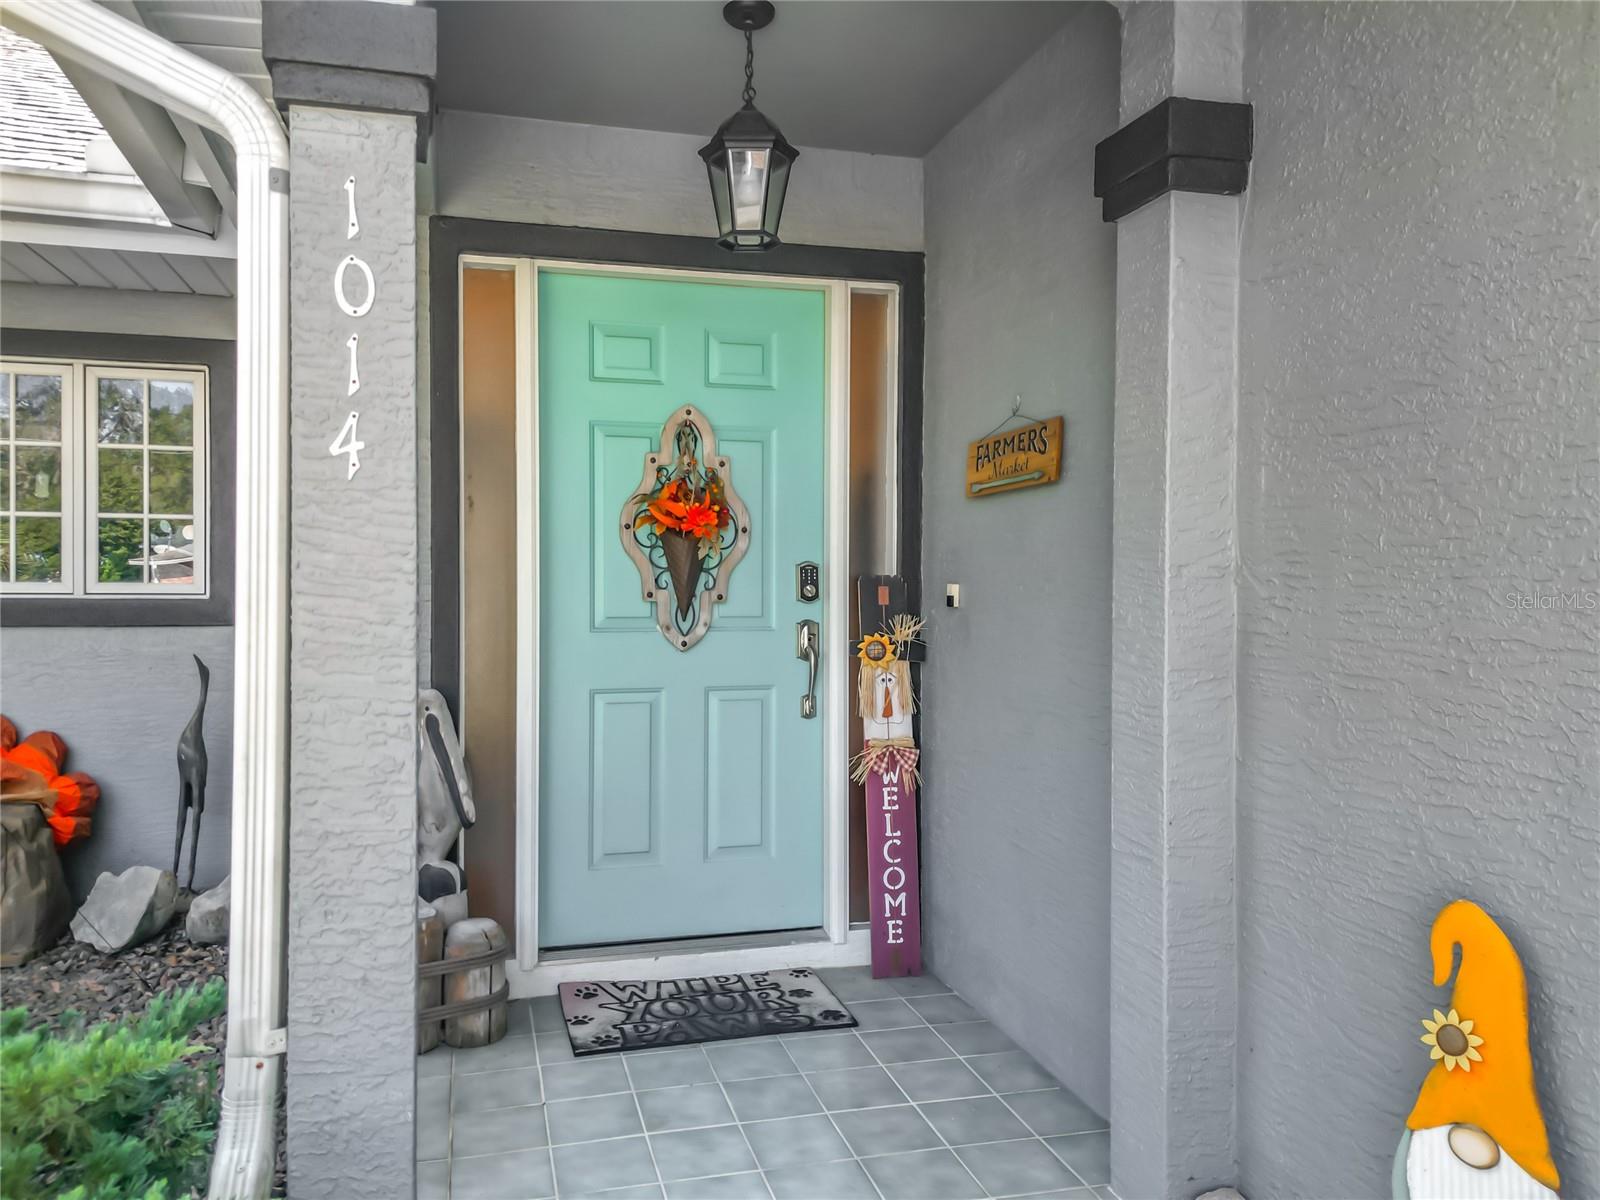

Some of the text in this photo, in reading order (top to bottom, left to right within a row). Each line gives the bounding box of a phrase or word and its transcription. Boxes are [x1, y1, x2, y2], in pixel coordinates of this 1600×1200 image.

[329, 176, 375, 480] 1014
[976, 425, 1048, 472] FARMERS
[882, 765, 907, 944] WELCOME
[592, 971, 782, 1003] WIPE
[598, 987, 799, 1025] YOUR
[613, 1010, 814, 1047] PAWS
